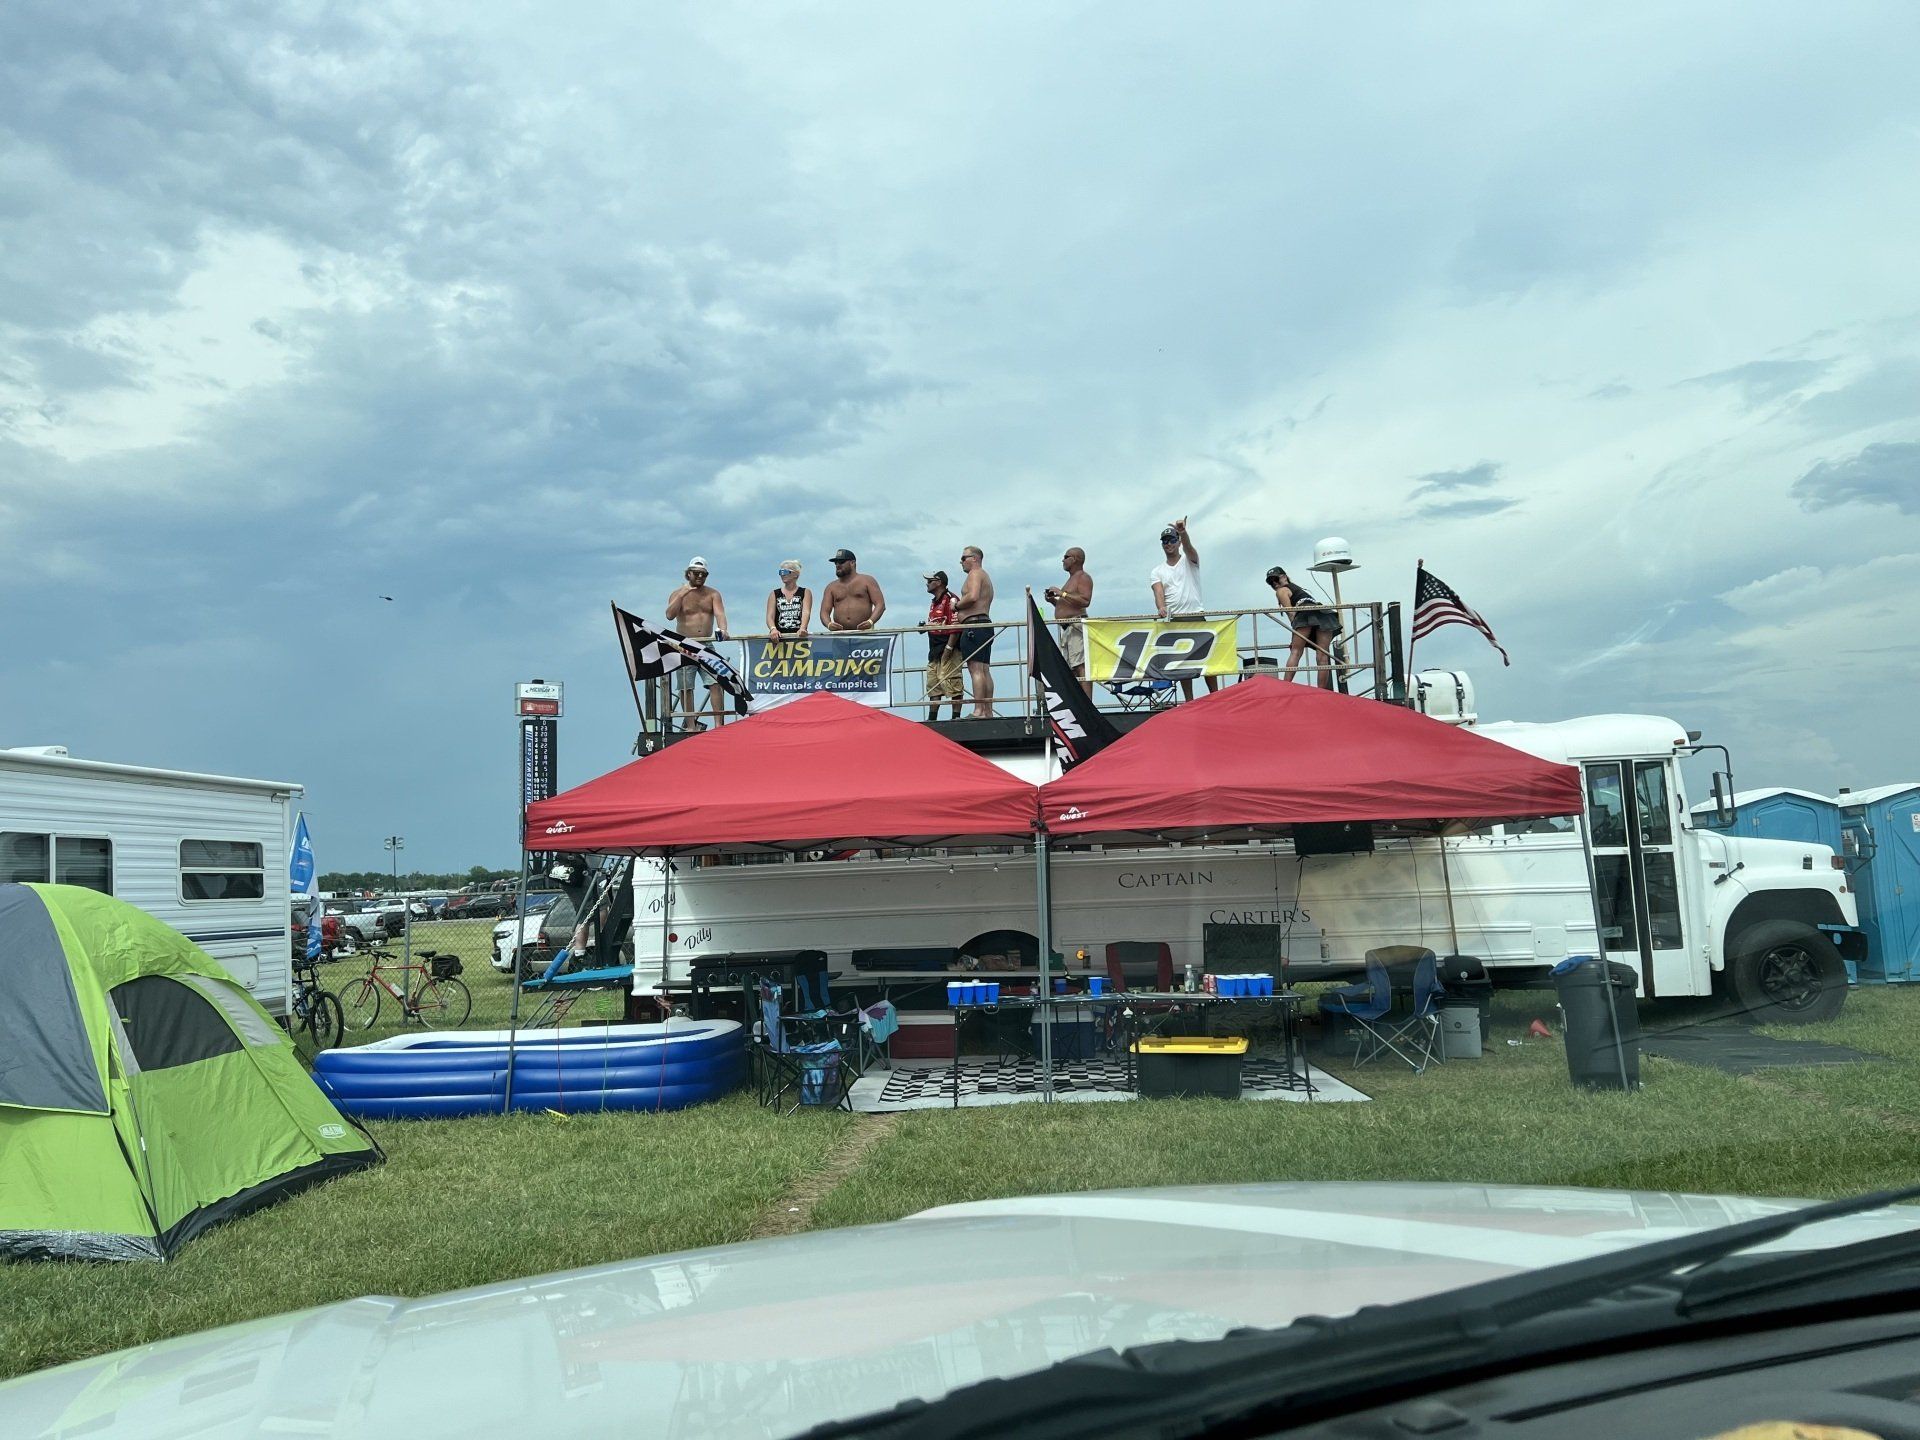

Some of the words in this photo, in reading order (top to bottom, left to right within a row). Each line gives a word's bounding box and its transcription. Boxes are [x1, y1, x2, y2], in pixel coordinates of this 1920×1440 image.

[760, 640, 812, 659] MIS
[848, 648, 884, 658] .COM
[1111, 629, 1219, 680] 12
[754, 659, 883, 677] CAMPING
[756, 682, 771, 690] RV
[773, 681, 812, 690] Rentals
[815, 681, 823, 690] &
[825, 680, 878, 689] Campsites
[1060, 811, 1088, 820] QUEST
[545, 825, 575, 834] QUEST
[1118, 871, 1213, 889] CAPTAIN
[648, 891, 676, 914] Diy
[1209, 908, 1311, 925] CARTER'S
[684, 927, 712, 949] Dilly
